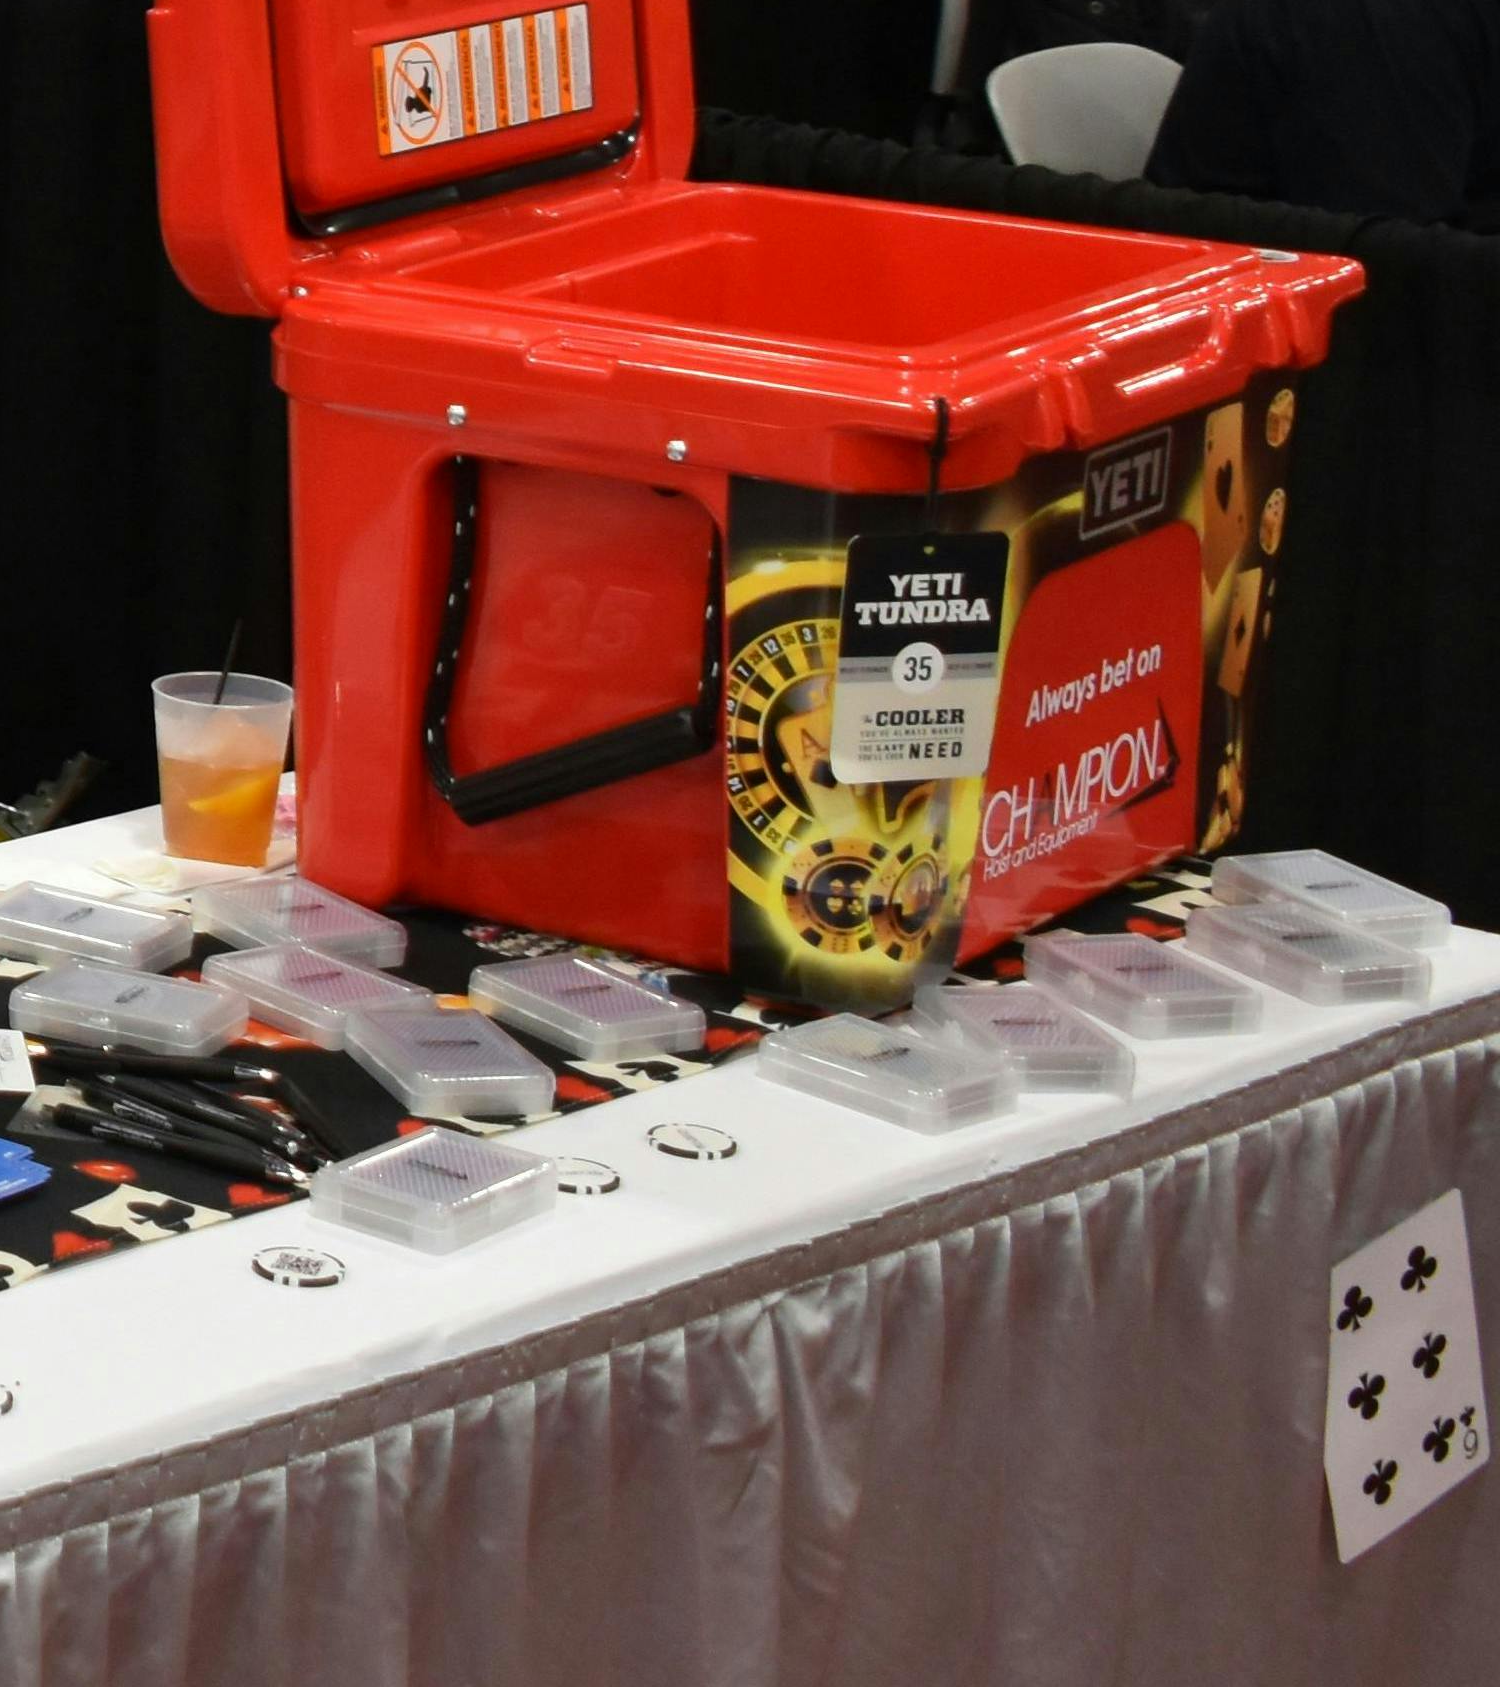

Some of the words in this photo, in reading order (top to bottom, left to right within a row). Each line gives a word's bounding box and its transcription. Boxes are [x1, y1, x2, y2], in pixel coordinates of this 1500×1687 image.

[1090, 448, 1164, 518] YETI
[888, 572, 965, 598] YETI
[854, 598, 991, 626] TUNDRA
[903, 655, 933, 682] 35
[1025, 672, 1097, 728] Always
[1100, 648, 1134, 694] bet
[1136, 644, 1162, 678] on
[875, 708, 966, 727] COOLER
[908, 741, 963, 760] NEED
[982, 719, 1162, 858] CHAMPION
[982, 851, 1015, 883] Hoist
[1013, 842, 1037, 868] and
[1036, 811, 1099, 856] Equipment
